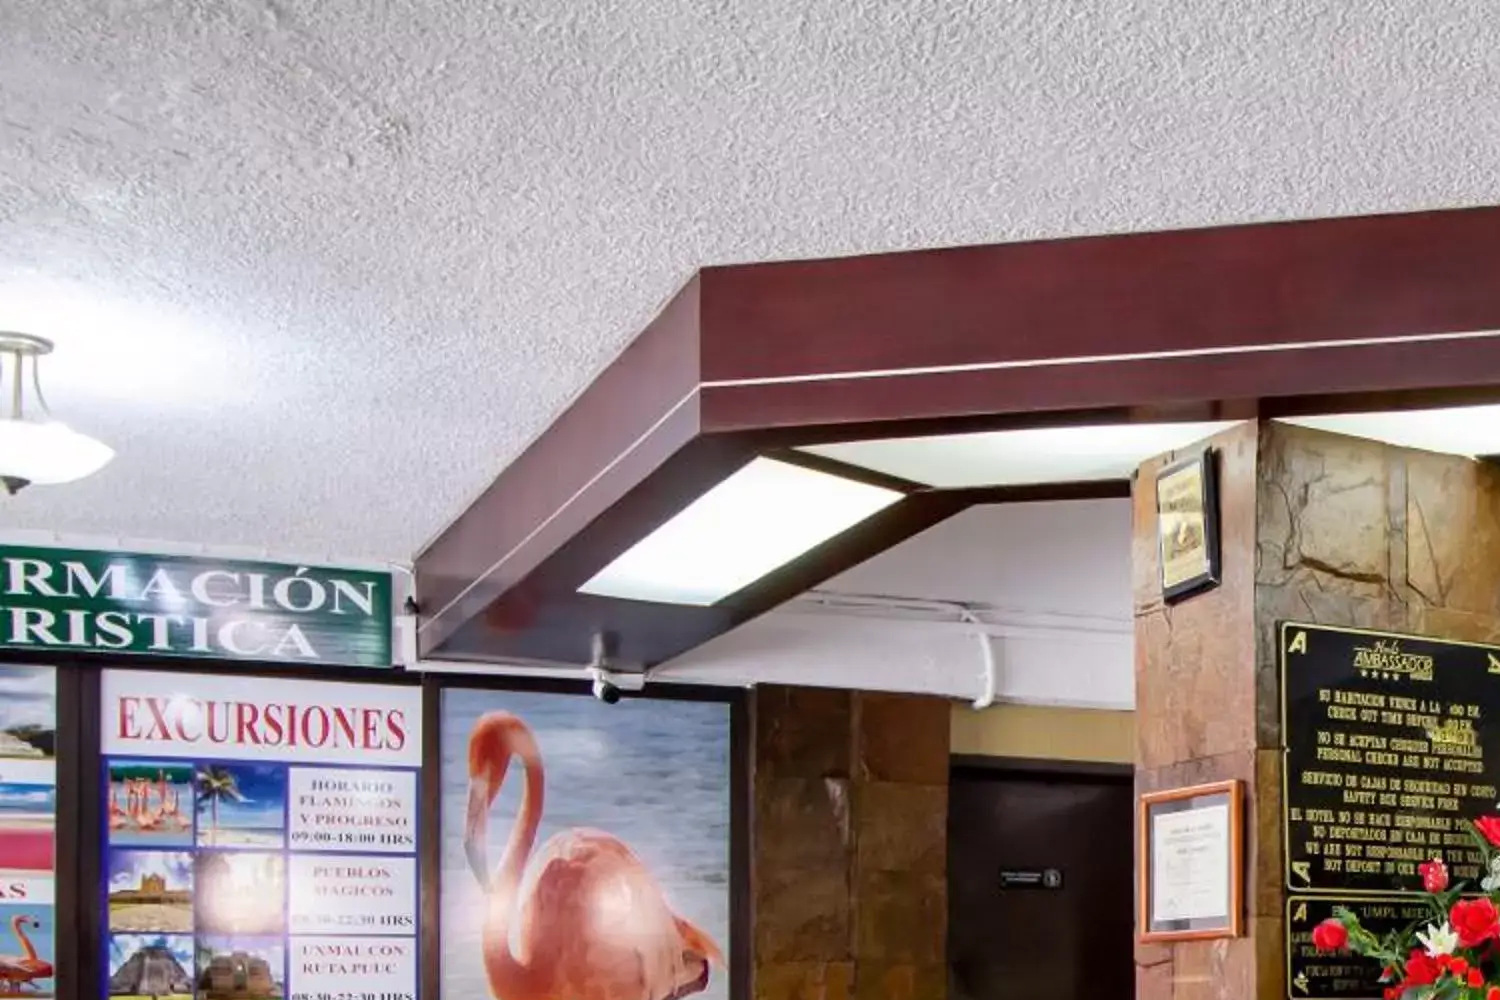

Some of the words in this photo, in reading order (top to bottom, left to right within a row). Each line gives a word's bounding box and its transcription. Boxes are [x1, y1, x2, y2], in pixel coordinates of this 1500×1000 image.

[0, 605, 321, 658] RISTICA
[1352, 650, 1433, 674] AMBASSADOR
[1430, 700, 1440, 713] LA
[1327, 705, 1357, 720] CHECK
[1360, 709, 1378, 722] OUT
[1381, 711, 1403, 725] TIME
[118, 696, 405, 752] EXCURSIONES
[1318, 731, 1331, 745] NO
[1334, 733, 1345, 746] SE
[1349, 735, 1387, 749] ACEPTAN
[1317, 747, 1362, 763] PERSONAL
[1423, 756, 1440, 769] NOT
[311, 779, 394, 793] HORARIO
[1302, 771, 1343, 787] SERVICIO
[1346, 774, 1357, 788] DE
[1360, 775, 1387, 790] CAJAS
[300, 812, 310, 824] Y
[315, 814, 407, 826] PROGRESO
[1291, 807, 1302, 821] EL
[1305, 808, 1335, 823] HOTEL
[1338, 810, 1351, 825] NO
[380, 833, 413, 845] HRS
[1405, 831, 1427, 844] CAJA
[313, 865, 391, 879] PUEBLOS
[380, 914, 414, 927] HRS
[302, 944, 359, 957] UXMAL
[367, 944, 404, 956] CON
[303, 962, 348, 975] RUTA
